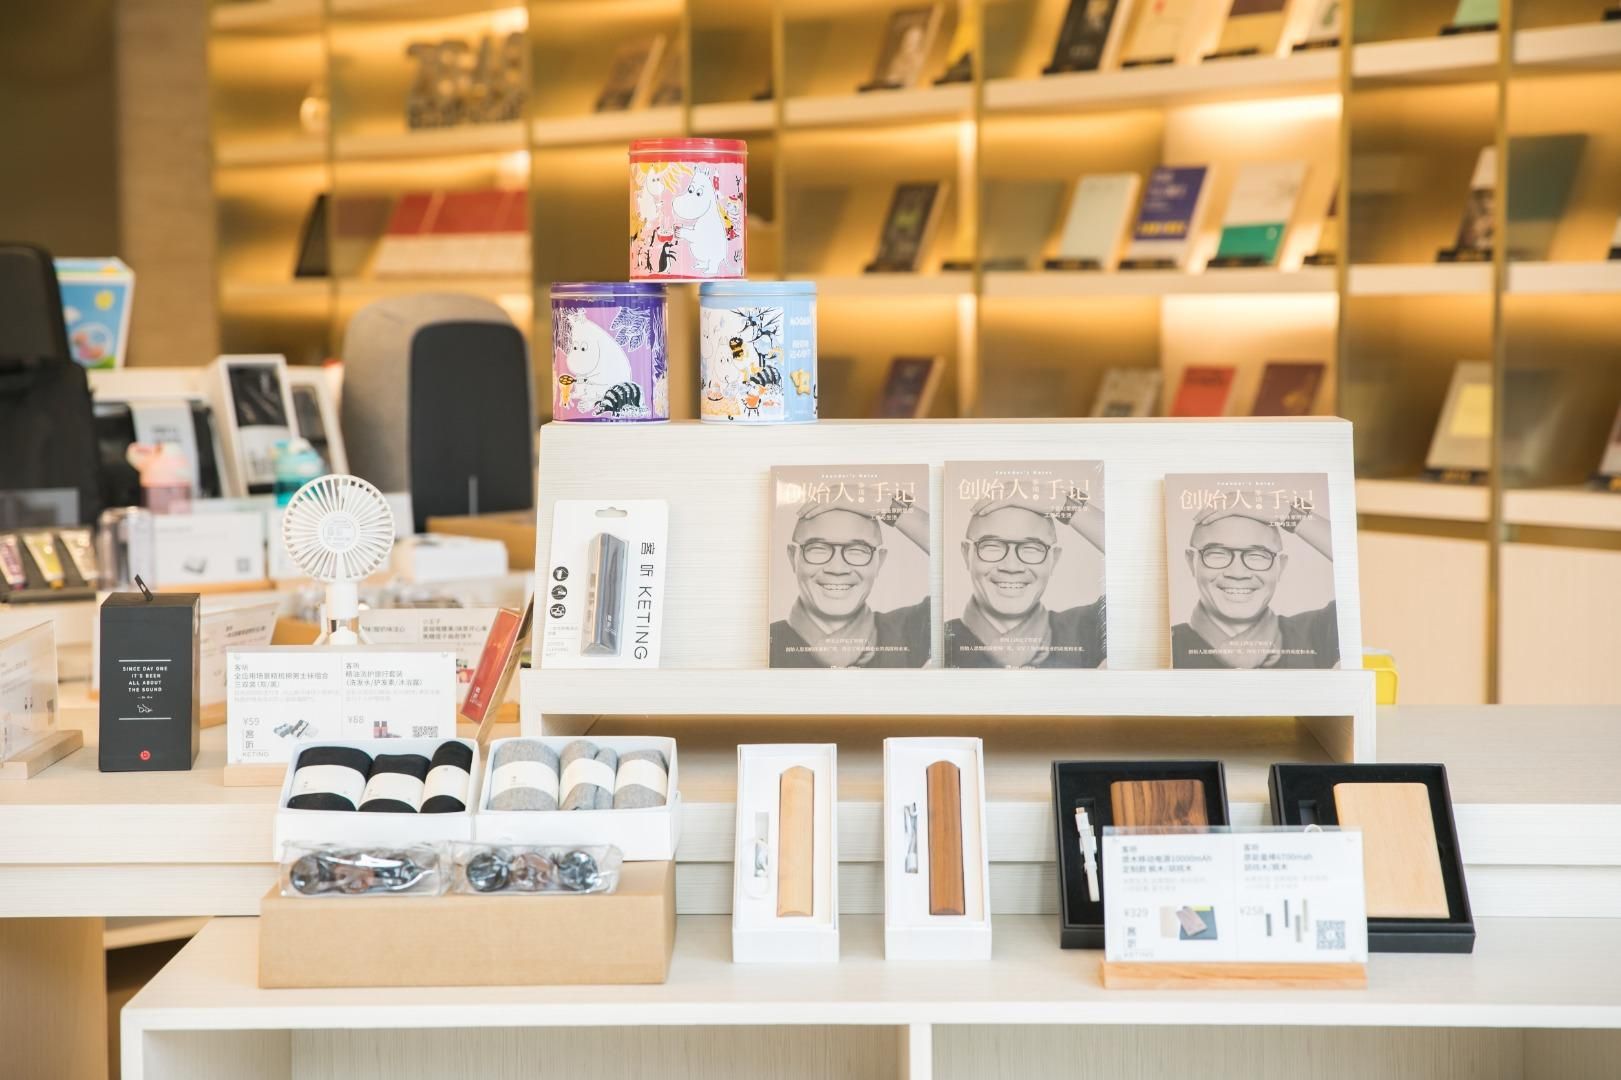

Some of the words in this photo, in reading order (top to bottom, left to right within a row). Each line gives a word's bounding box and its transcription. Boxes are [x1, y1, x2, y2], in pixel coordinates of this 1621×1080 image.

[870, 481, 916, 502] 手记
[959, 478, 1028, 500] 创始人
[1048, 479, 1090, 500] 手记
[1180, 489, 1252, 510] 创始人
[1269, 489, 1315, 510] 手记
[634, 586, 652, 660] KETING
